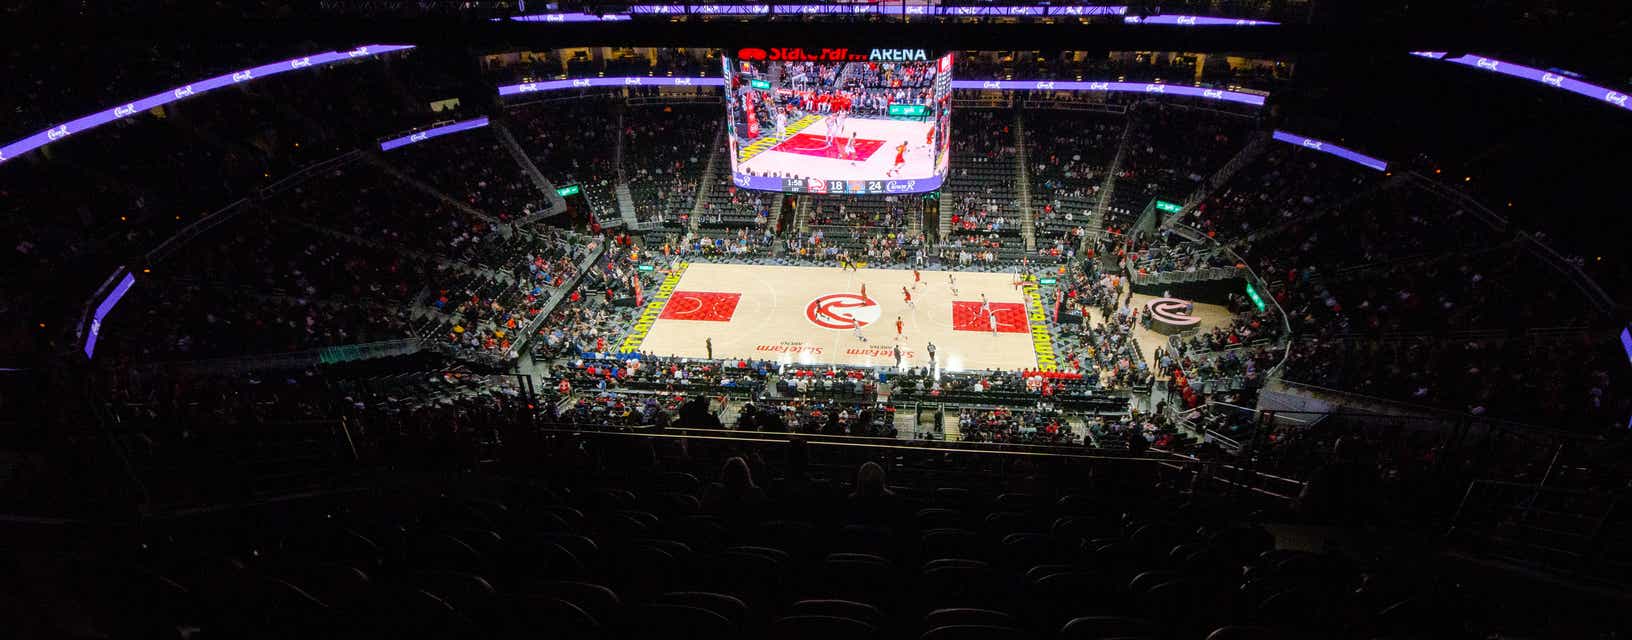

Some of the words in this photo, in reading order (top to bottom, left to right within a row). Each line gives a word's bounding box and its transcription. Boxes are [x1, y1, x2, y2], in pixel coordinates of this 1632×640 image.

[869, 48, 926, 60] ARENA
[830, 181, 843, 190] 18
[869, 181, 882, 190] 24
